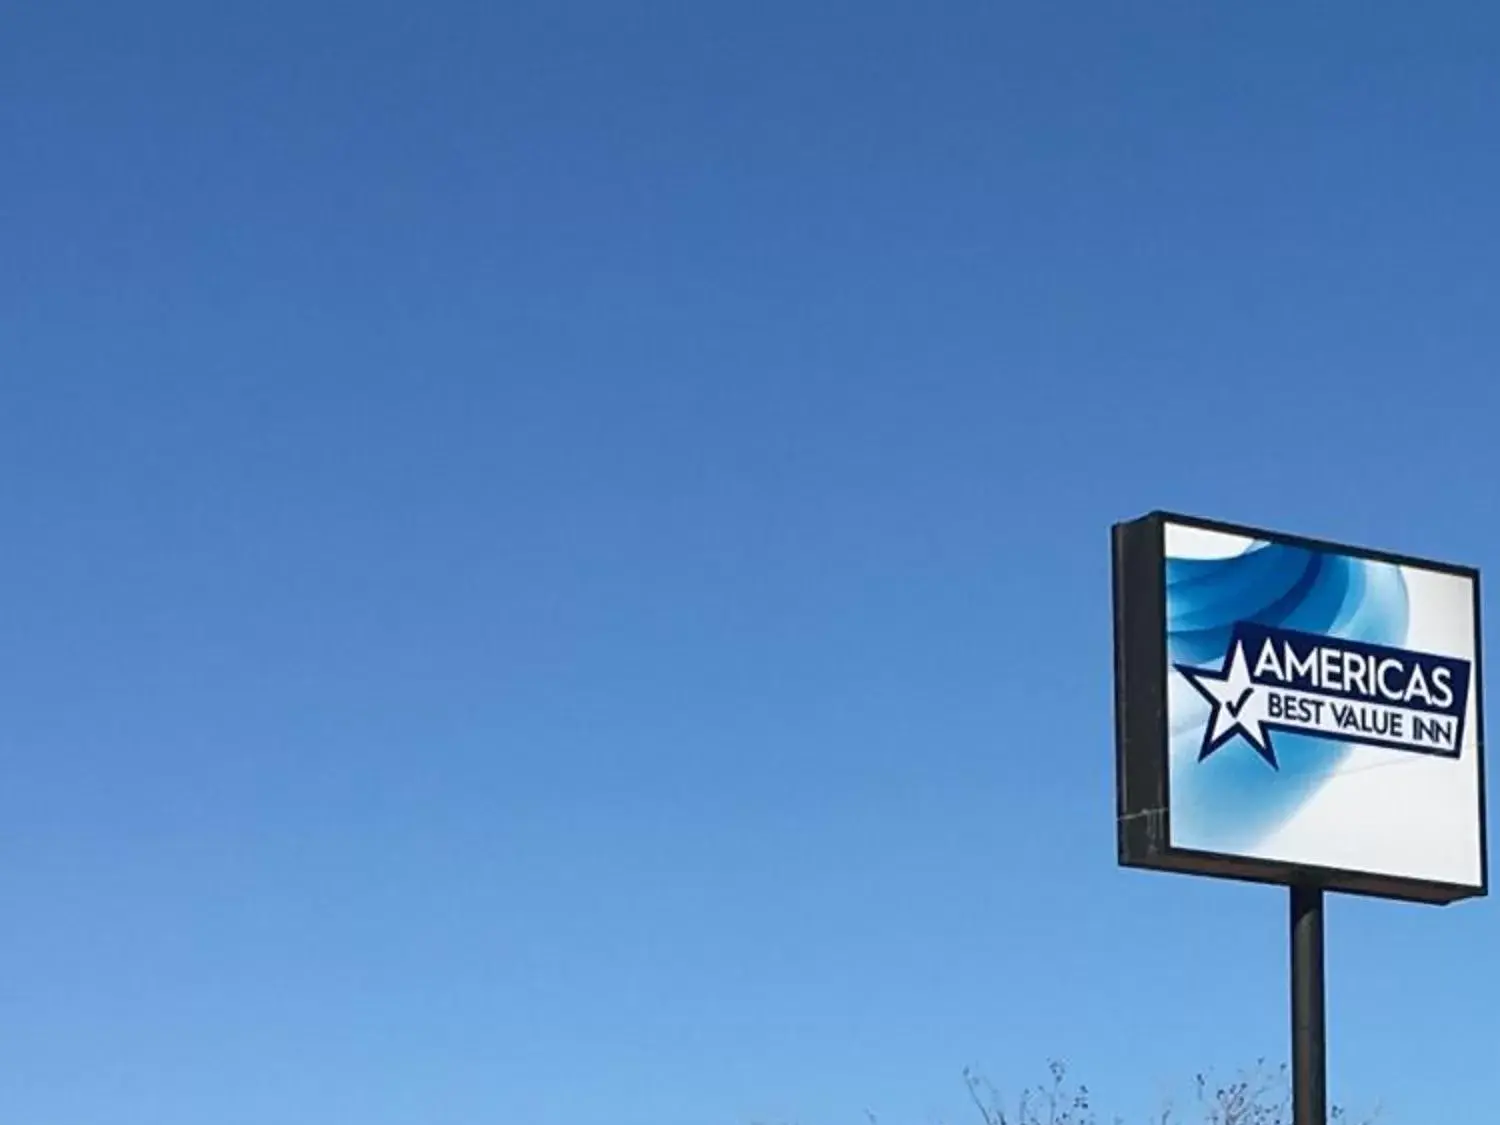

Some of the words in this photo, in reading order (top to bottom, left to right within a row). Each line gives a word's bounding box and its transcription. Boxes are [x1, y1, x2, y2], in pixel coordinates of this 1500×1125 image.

[1253, 636, 1454, 708] AMERICAS
[1268, 691, 1325, 725] BEST
[1329, 701, 1404, 737] VALUE
[1412, 715, 1452, 744] INN
